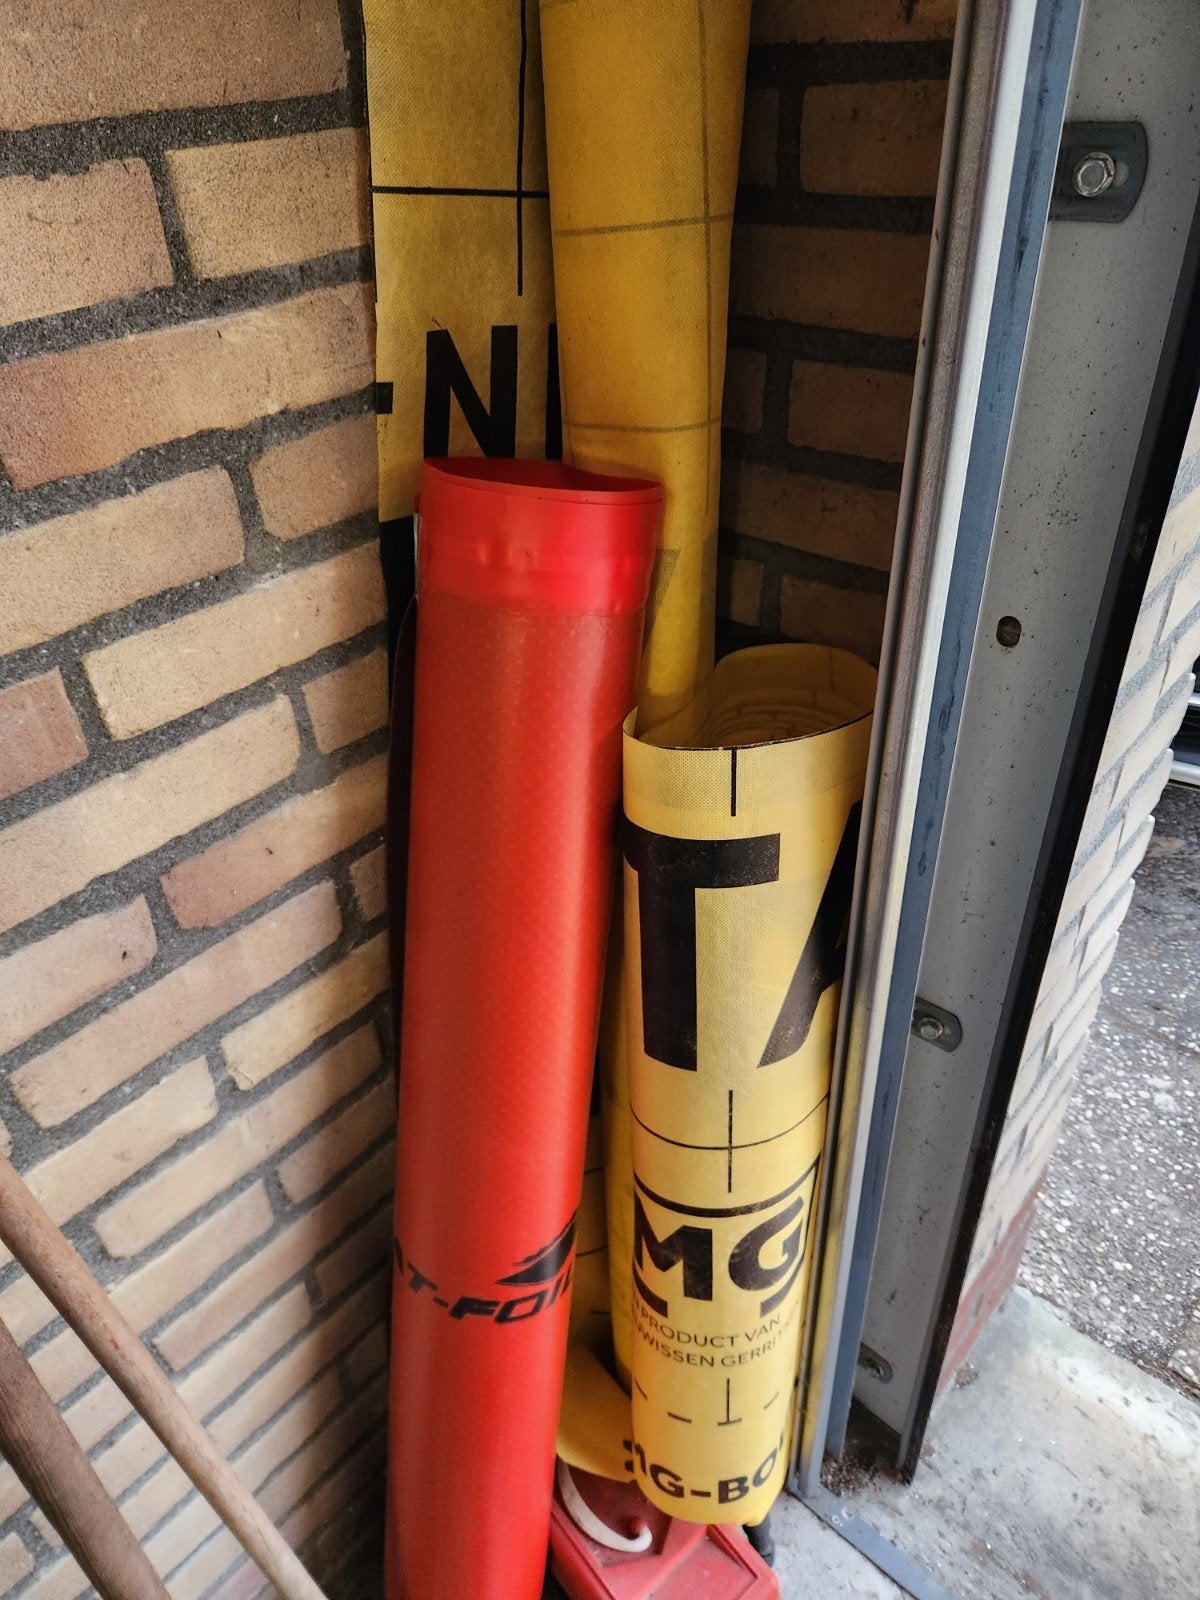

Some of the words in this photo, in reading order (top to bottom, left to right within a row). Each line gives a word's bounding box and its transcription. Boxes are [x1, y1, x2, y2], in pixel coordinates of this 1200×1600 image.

[633, 1185, 805, 1301] MG
[642, 1306, 740, 1348] PRODUCT
[745, 1313, 780, 1342] VAN
